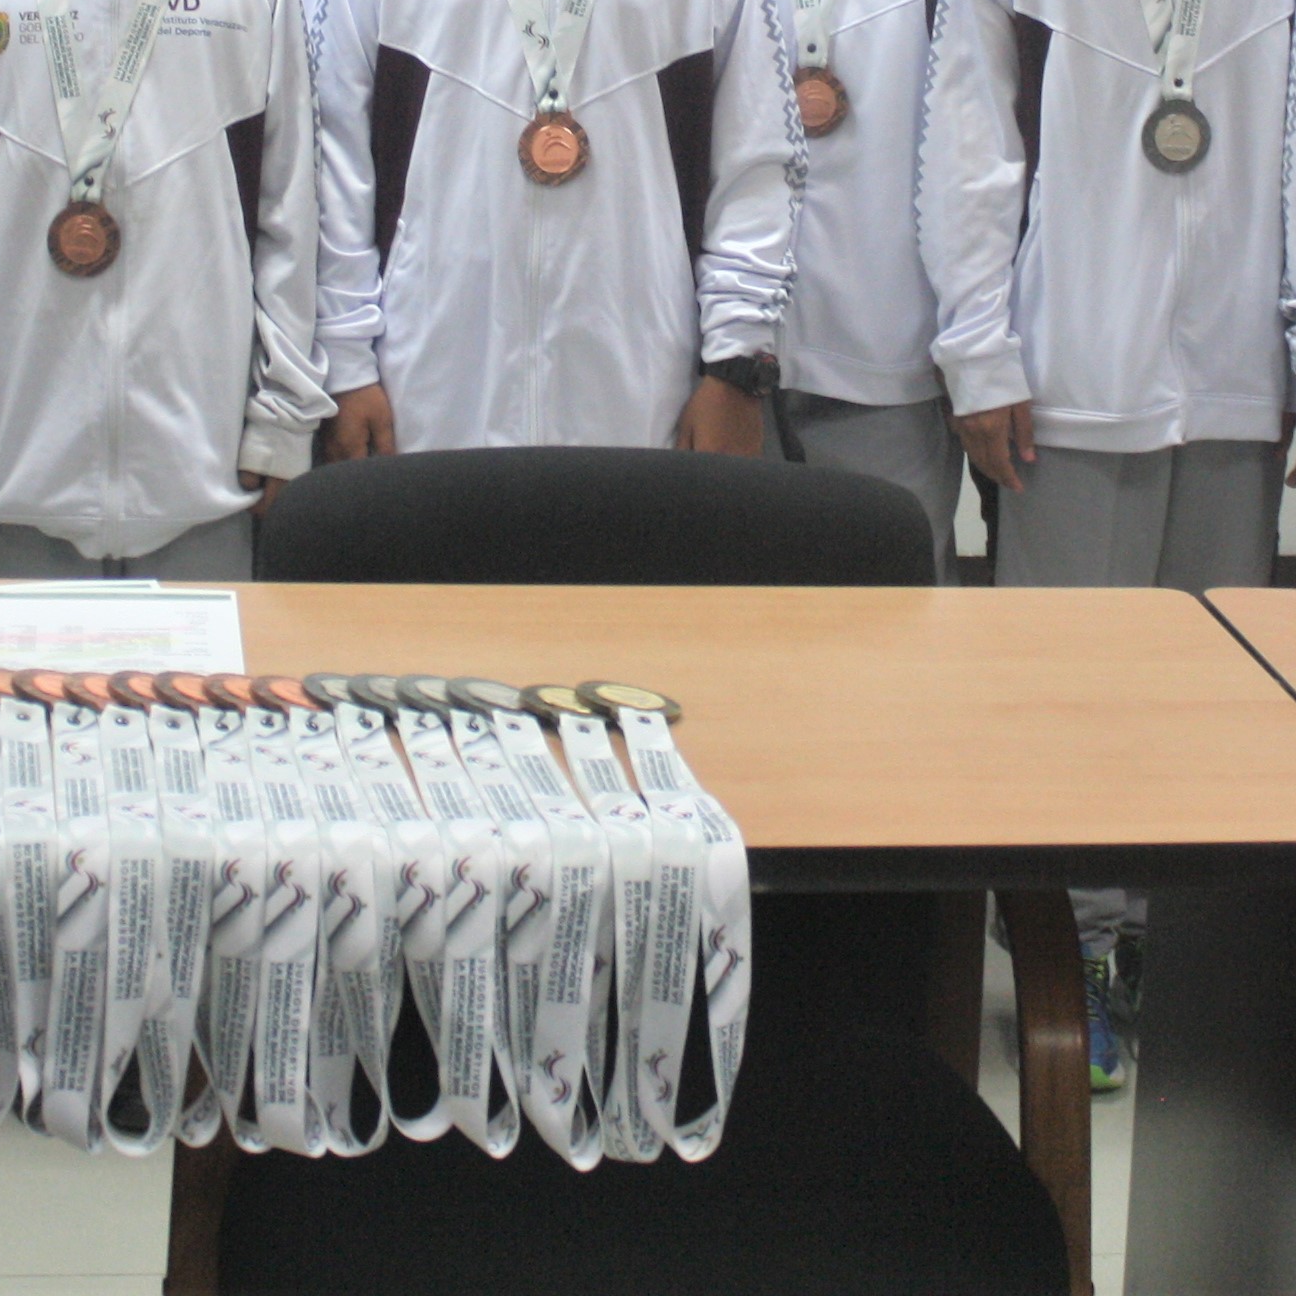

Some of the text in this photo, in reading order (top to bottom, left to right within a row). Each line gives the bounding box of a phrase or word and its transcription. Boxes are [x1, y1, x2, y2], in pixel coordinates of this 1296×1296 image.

[175, 27, 211, 37] Deporte
[115, 859, 127, 1000] JUEGOS DEPORTIVOS
[545, 866, 569, 1000] JUEGOS DEPORTIVOS
[651, 864, 669, 999] JUEGOS DEPORTIVOS
[76, 951, 98, 1091] JUEGOS DEPORTIVOS
[287, 963, 304, 1103] JUEGOS DEPORTIVOS
[472, 959, 486, 1097] JUEGOS DEPORTIVOS
